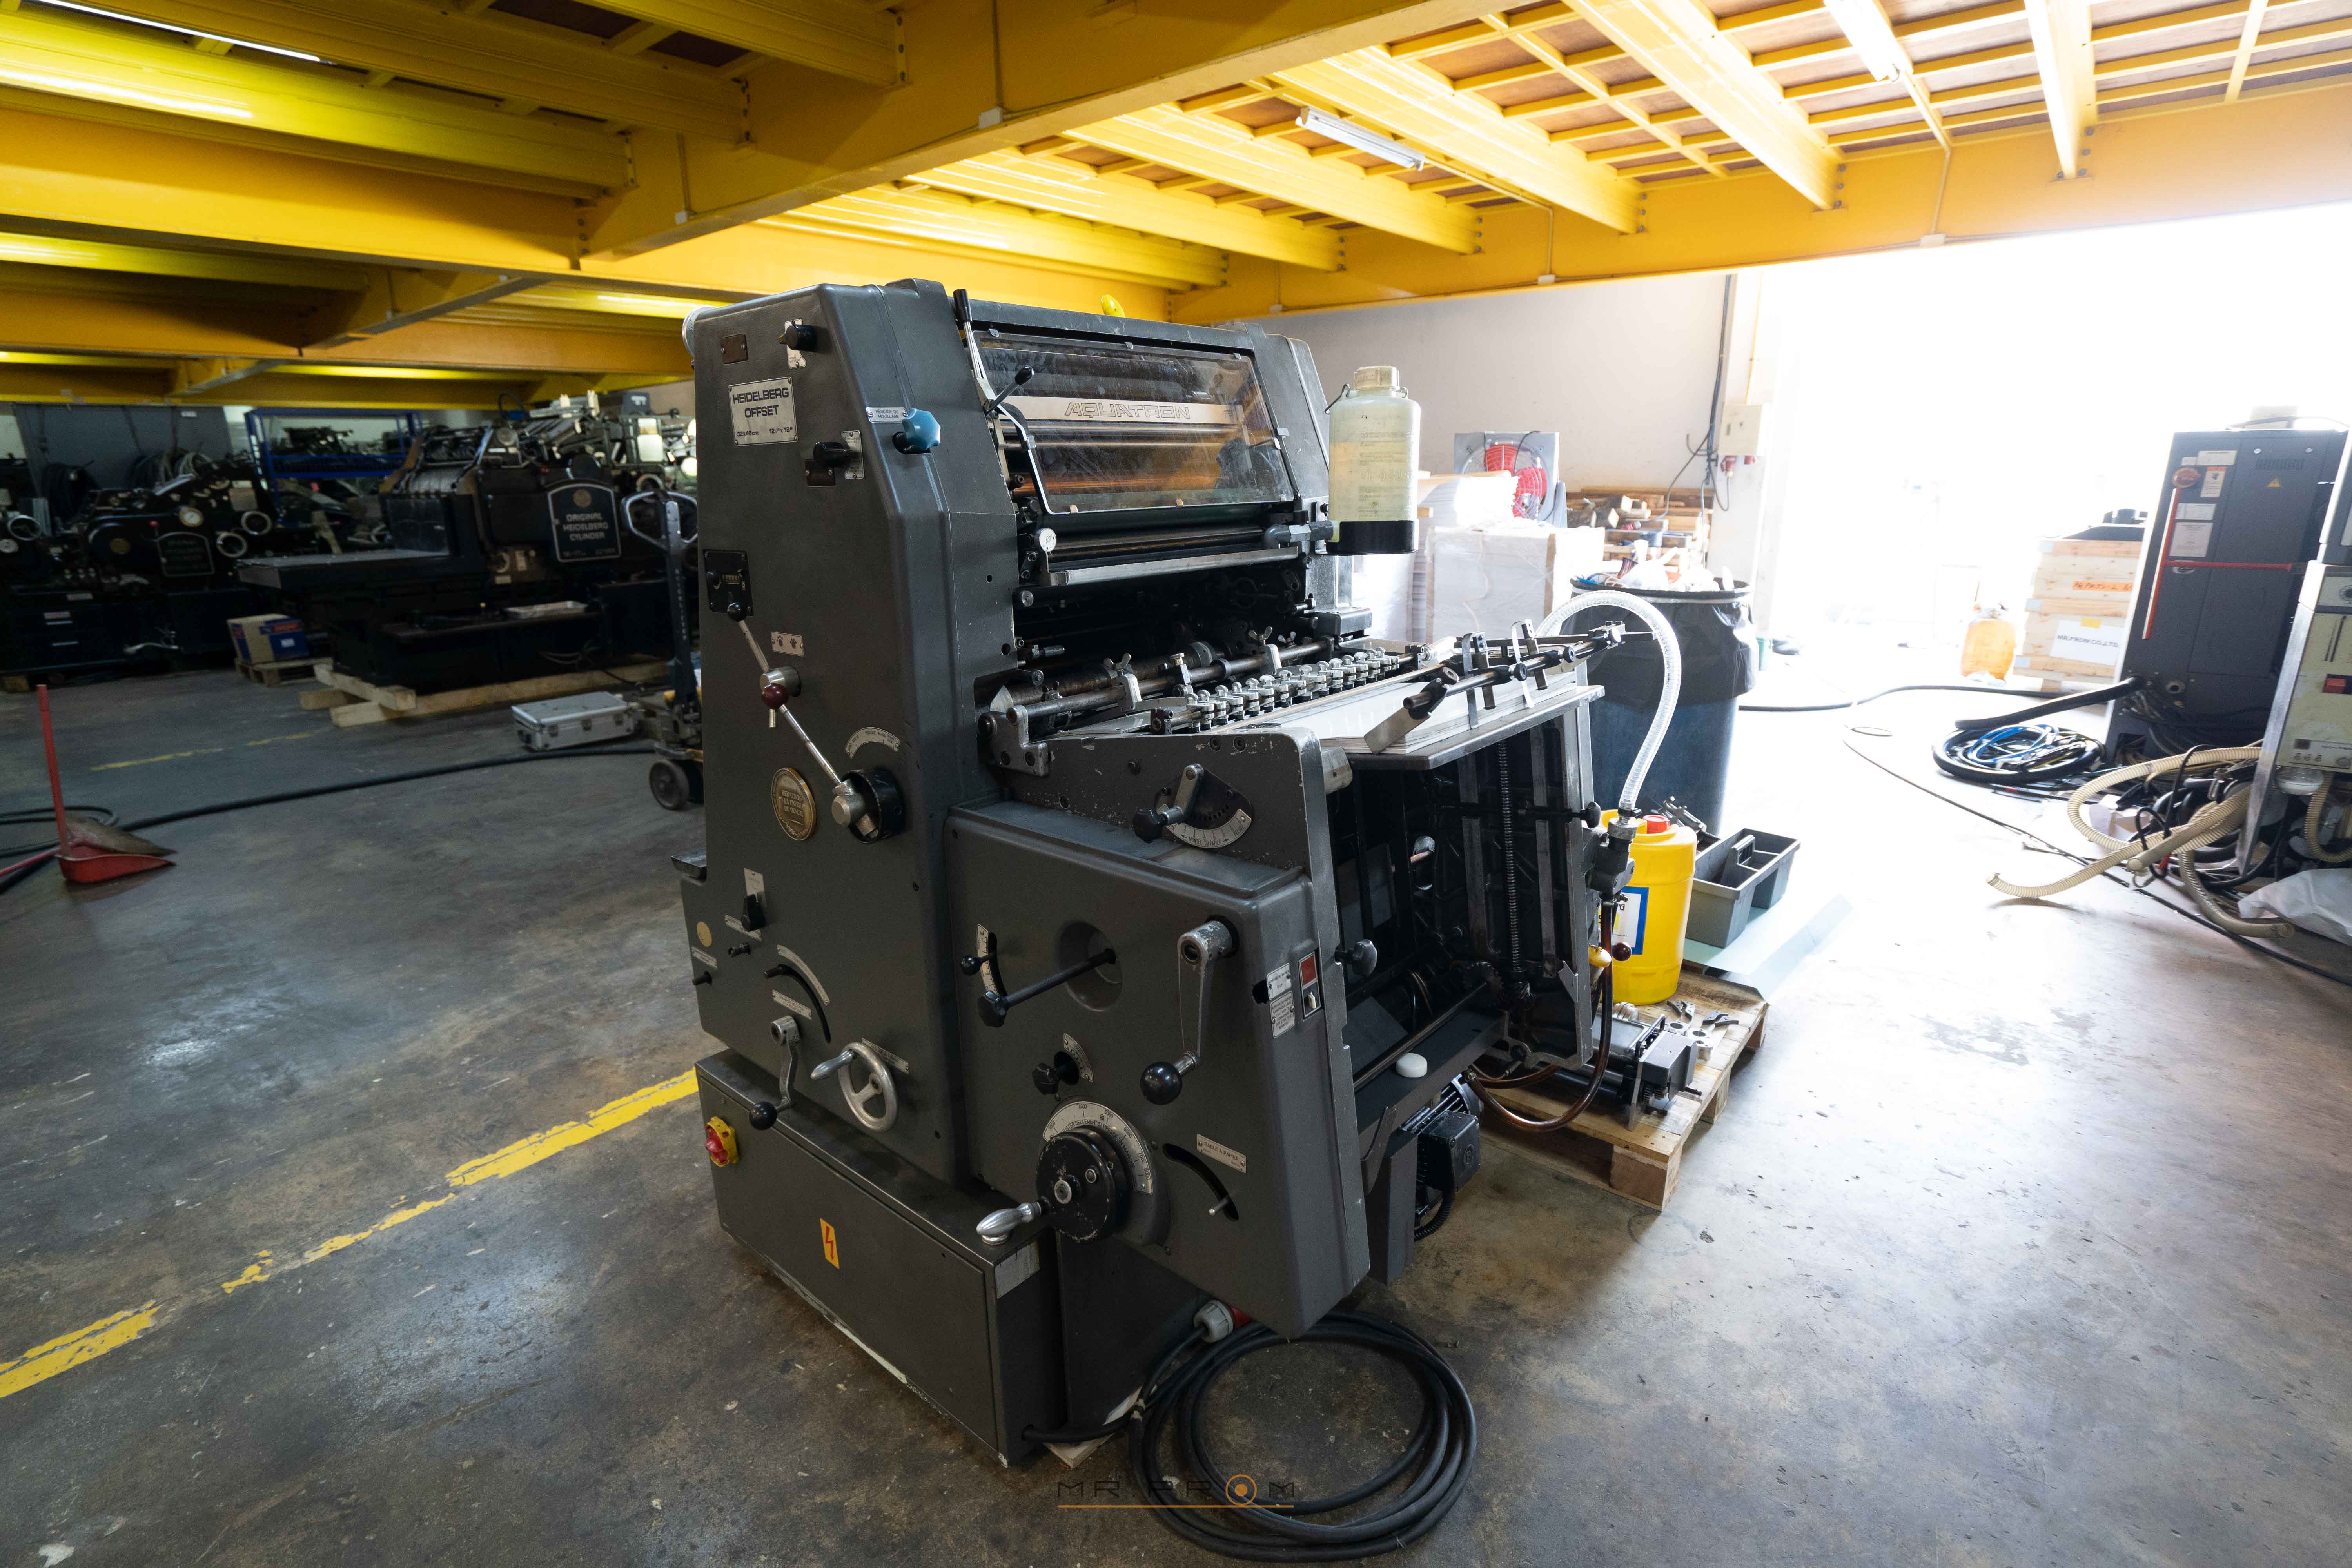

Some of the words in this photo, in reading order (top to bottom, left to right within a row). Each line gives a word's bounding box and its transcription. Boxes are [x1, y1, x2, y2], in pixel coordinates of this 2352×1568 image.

[733, 387, 789, 404] HEIDELBERG
[745, 405, 779, 418] OFFSET
[1065, 402, 1190, 419] AQUATRON
[566, 512, 602, 522] ORIGINAL
[563, 521, 608, 532] HEIDELBERG
[570, 532, 605, 541] CYLINDER
[1104, 1110, 1114, 1118] 5000
[1123, 1127, 1132, 1138] 6000
[1103, 1124, 1117, 1139] PRESSE
[1123, 1145, 1136, 1168] MARCHE
[1205, 1142, 1218, 1152] TABLE
[1223, 1151, 1239, 1161] PAPIER
